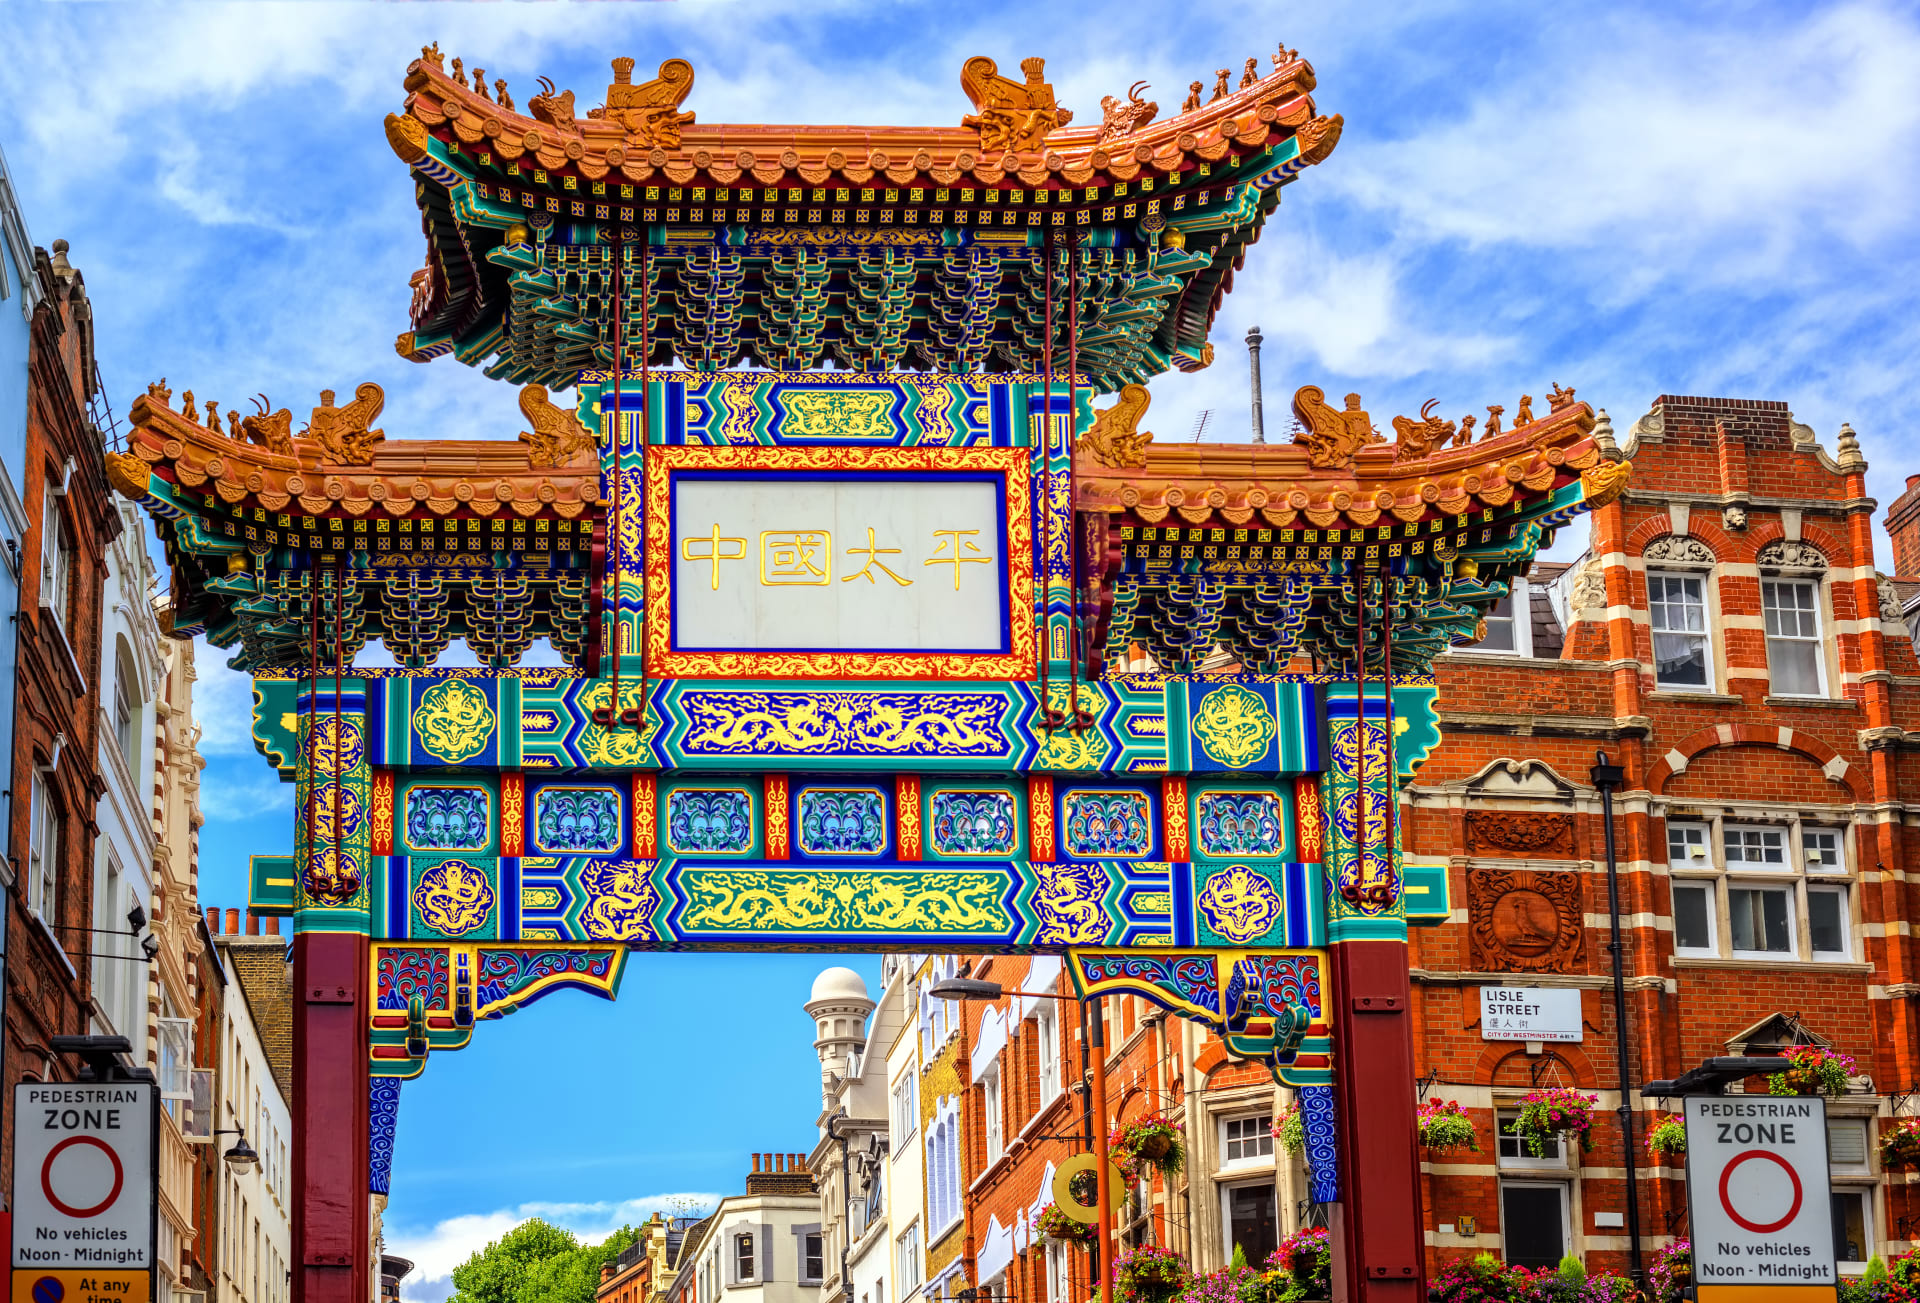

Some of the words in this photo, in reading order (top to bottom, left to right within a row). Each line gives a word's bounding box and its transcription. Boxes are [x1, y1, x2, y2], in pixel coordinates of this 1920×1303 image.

[682, 523, 992, 591] 中國太平
[1486, 990, 1524, 1002] LISLE
[1488, 1004, 1540, 1016] STREET
[30, 1090, 137, 1103] PEDESTRIAN
[1700, 1104, 1810, 1117] PEDESTRIAN
[44, 1109, 121, 1130] ZONE
[1717, 1123, 1796, 1144] ZONE
[36, 1227, 58, 1240] No
[63, 1227, 127, 1240] vehicles
[20, 1248, 60, 1261] Noon
[74, 1248, 143, 1263] Midnight
[1718, 1242, 1740, 1255] No
[1746, 1242, 1811, 1256] vehicles
[1703, 1263, 1744, 1277] Noon
[1758, 1263, 1829, 1279] Midnight
[80, 1278, 97, 1290] At
[103, 1281, 130, 1294] any
